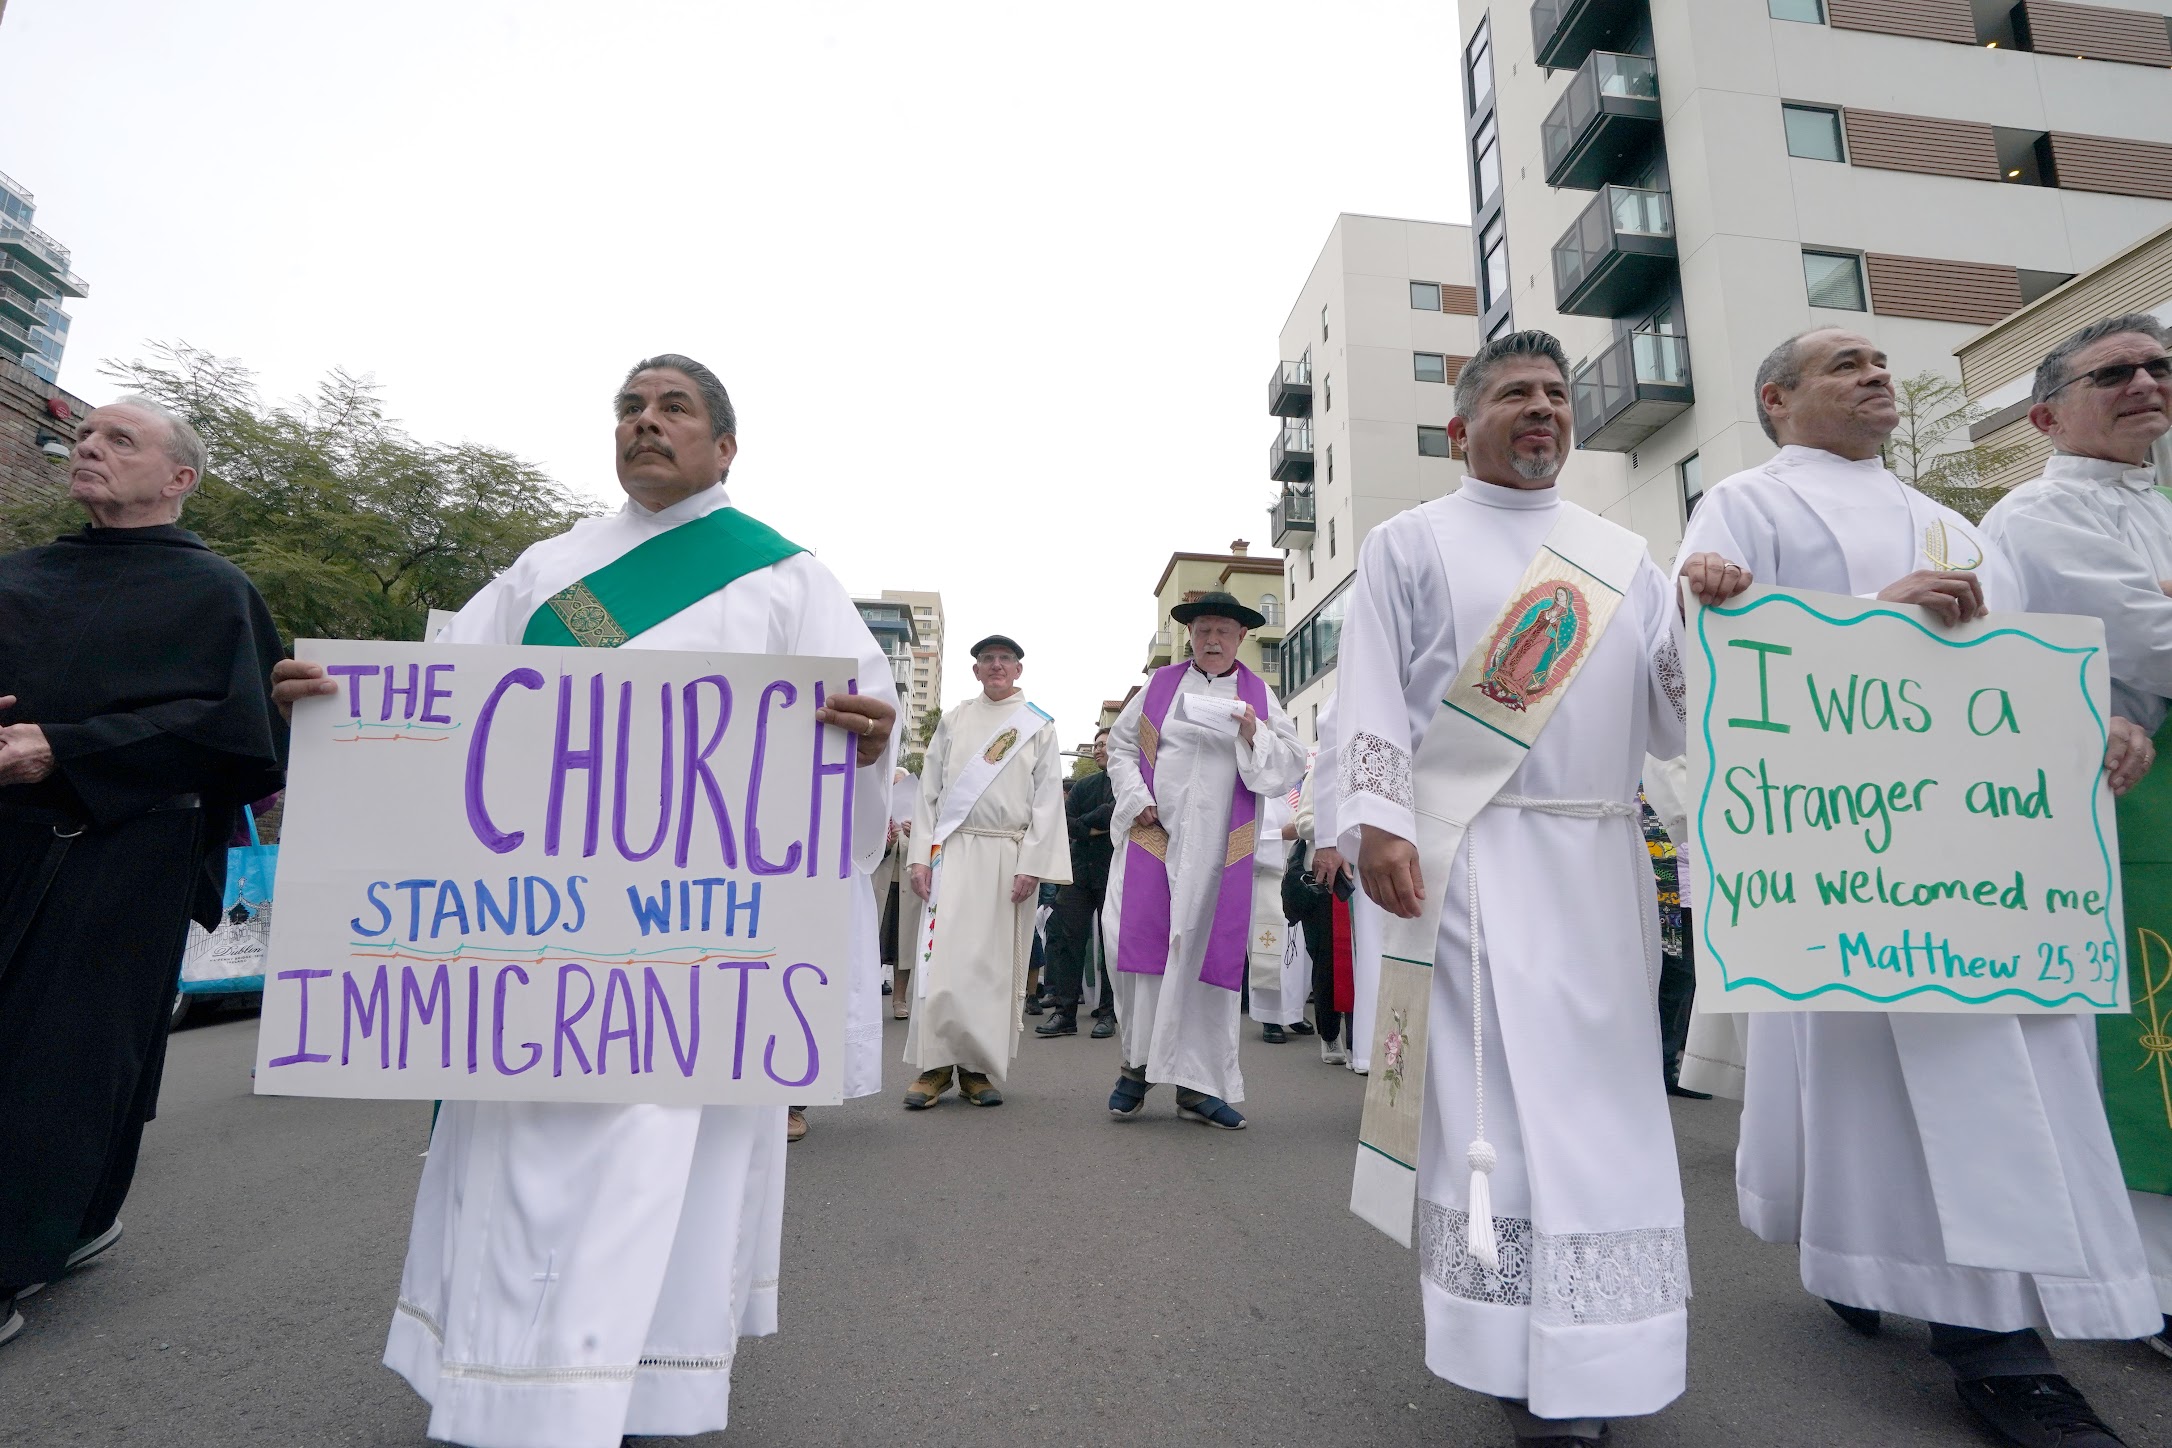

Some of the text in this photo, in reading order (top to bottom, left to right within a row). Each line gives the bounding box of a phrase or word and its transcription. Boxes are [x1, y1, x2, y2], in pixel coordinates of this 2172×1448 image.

[327, 664, 455, 724] THE
[1728, 639, 2021, 737] I was a
[465, 668, 857, 880] CHURCH
[1724, 757, 2053, 854] Stranger and
[350, 876, 762, 942] STANDS WITH
[1715, 866, 2106, 927] you welcomed me
[212, 944, 263, 957] Dublin
[1838, 928, 2020, 979] Matthew
[269, 962, 829, 1087] IMMIGRANTS
